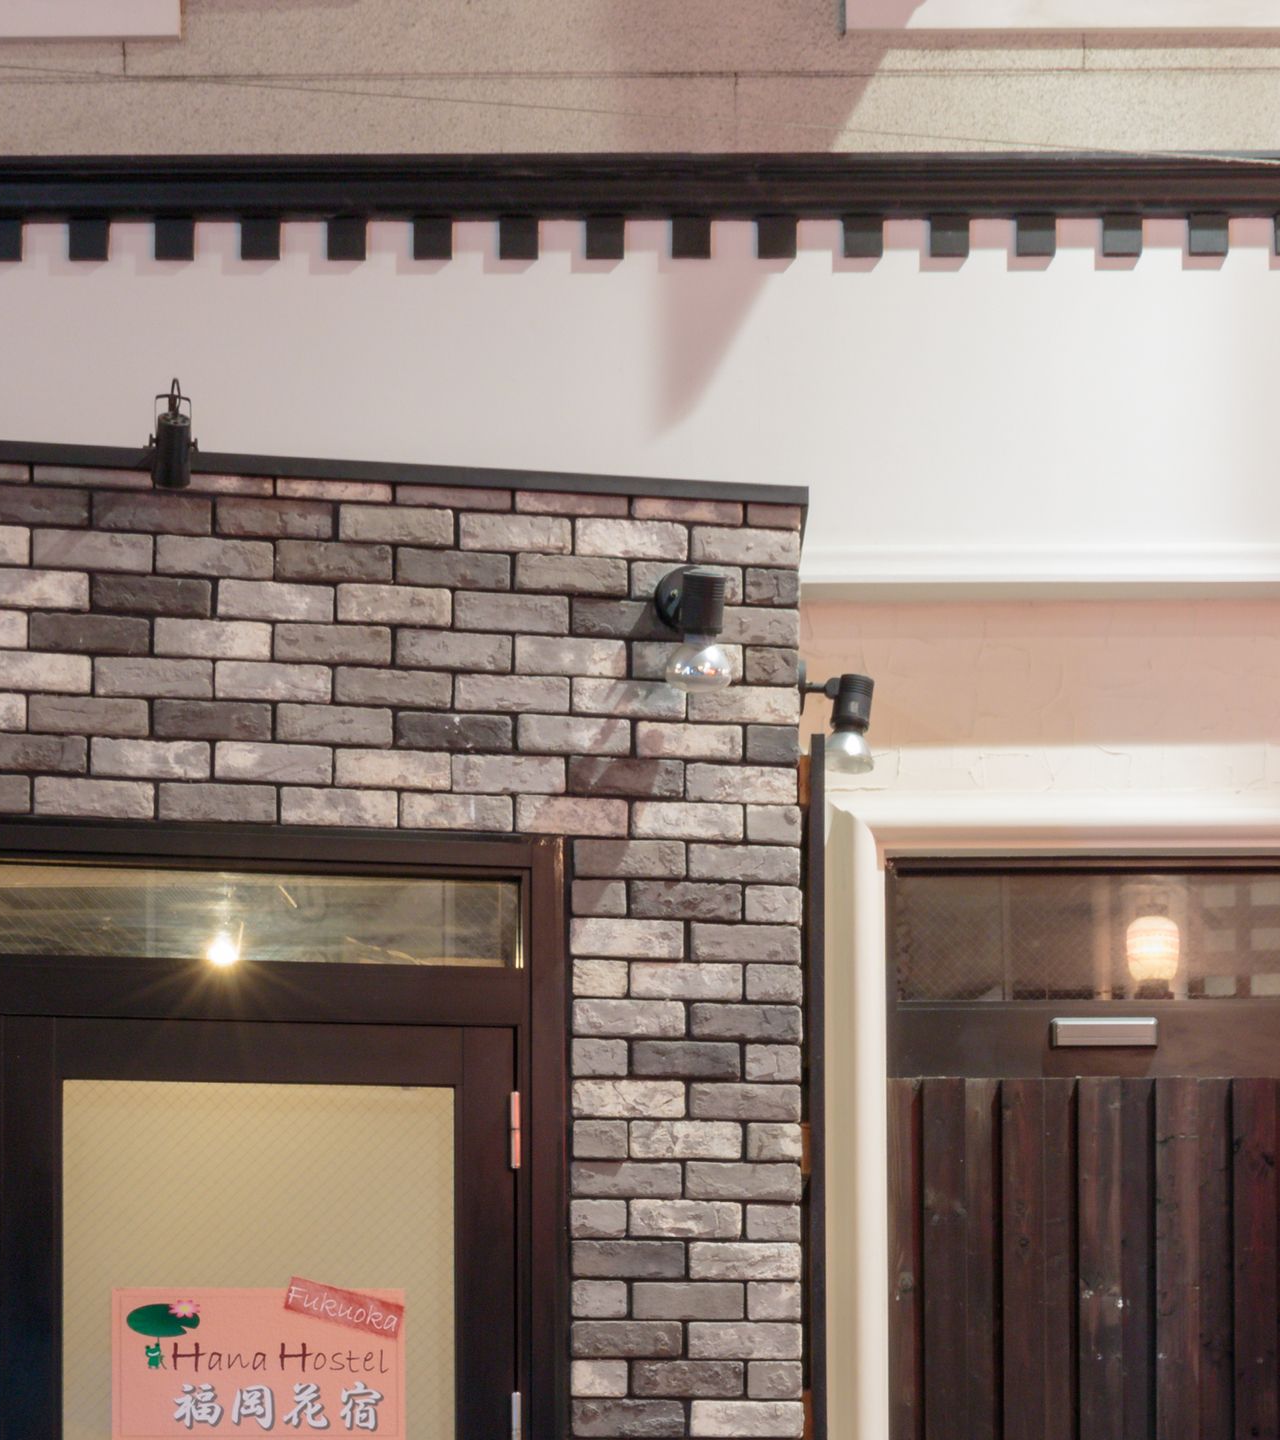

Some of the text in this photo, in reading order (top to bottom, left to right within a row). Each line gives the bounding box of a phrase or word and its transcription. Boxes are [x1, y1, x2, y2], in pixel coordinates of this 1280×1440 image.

[287, 1285, 399, 1332] Fukuoka
[172, 1341, 390, 1374] Hana Hostel
[172, 1380, 386, 1431] 福岡花宿
